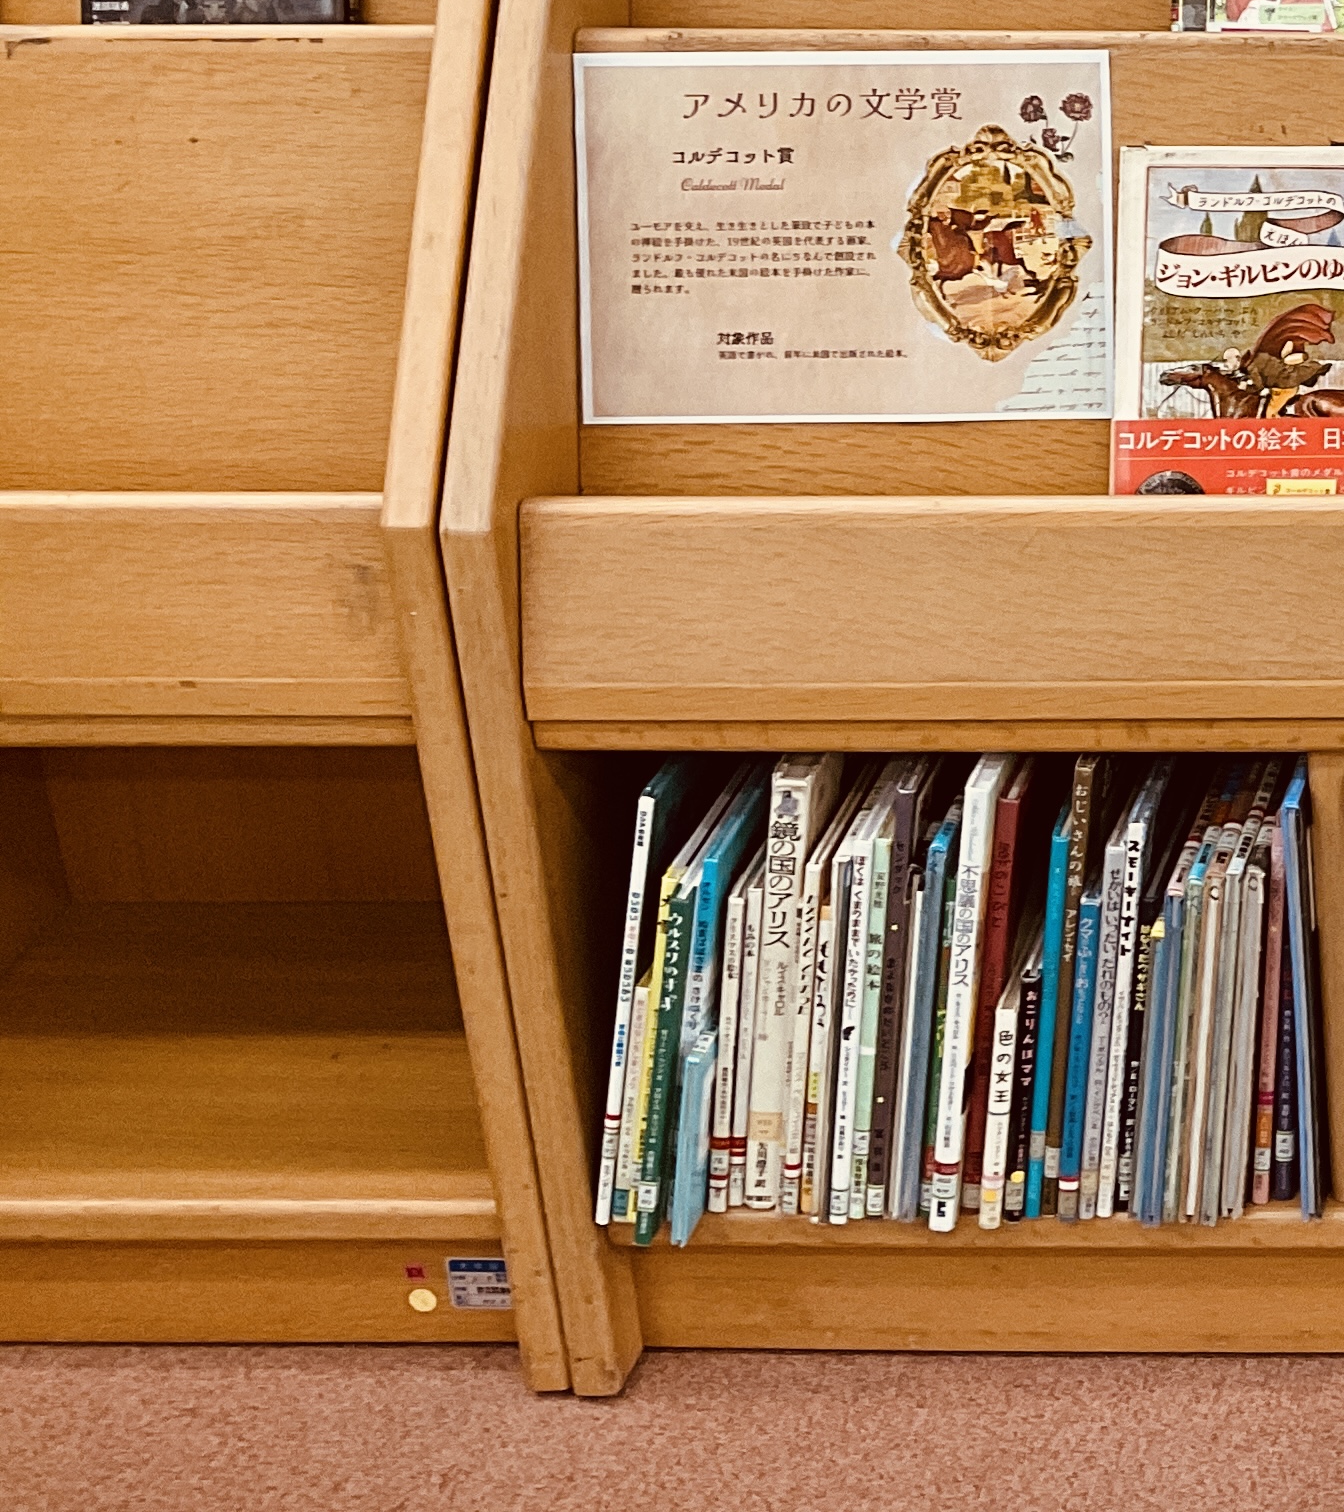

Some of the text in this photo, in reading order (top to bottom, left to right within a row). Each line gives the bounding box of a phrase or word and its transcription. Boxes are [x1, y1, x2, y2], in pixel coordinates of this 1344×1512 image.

[681, 87, 963, 122] アメリカの文学賞
[671, 146, 795, 166] コルデコット賞
[716, 331, 775, 346] 対象作品
[1117, 428, 1306, 452] コルデコットの絵本
[763, 820, 801, 948] 鏡の国のアリス
[1119, 840, 1142, 957] スモーキーナイト
[952, 864, 983, 987] 不思議の国のアリス
[992, 1030, 1014, 1104] 色の女王
